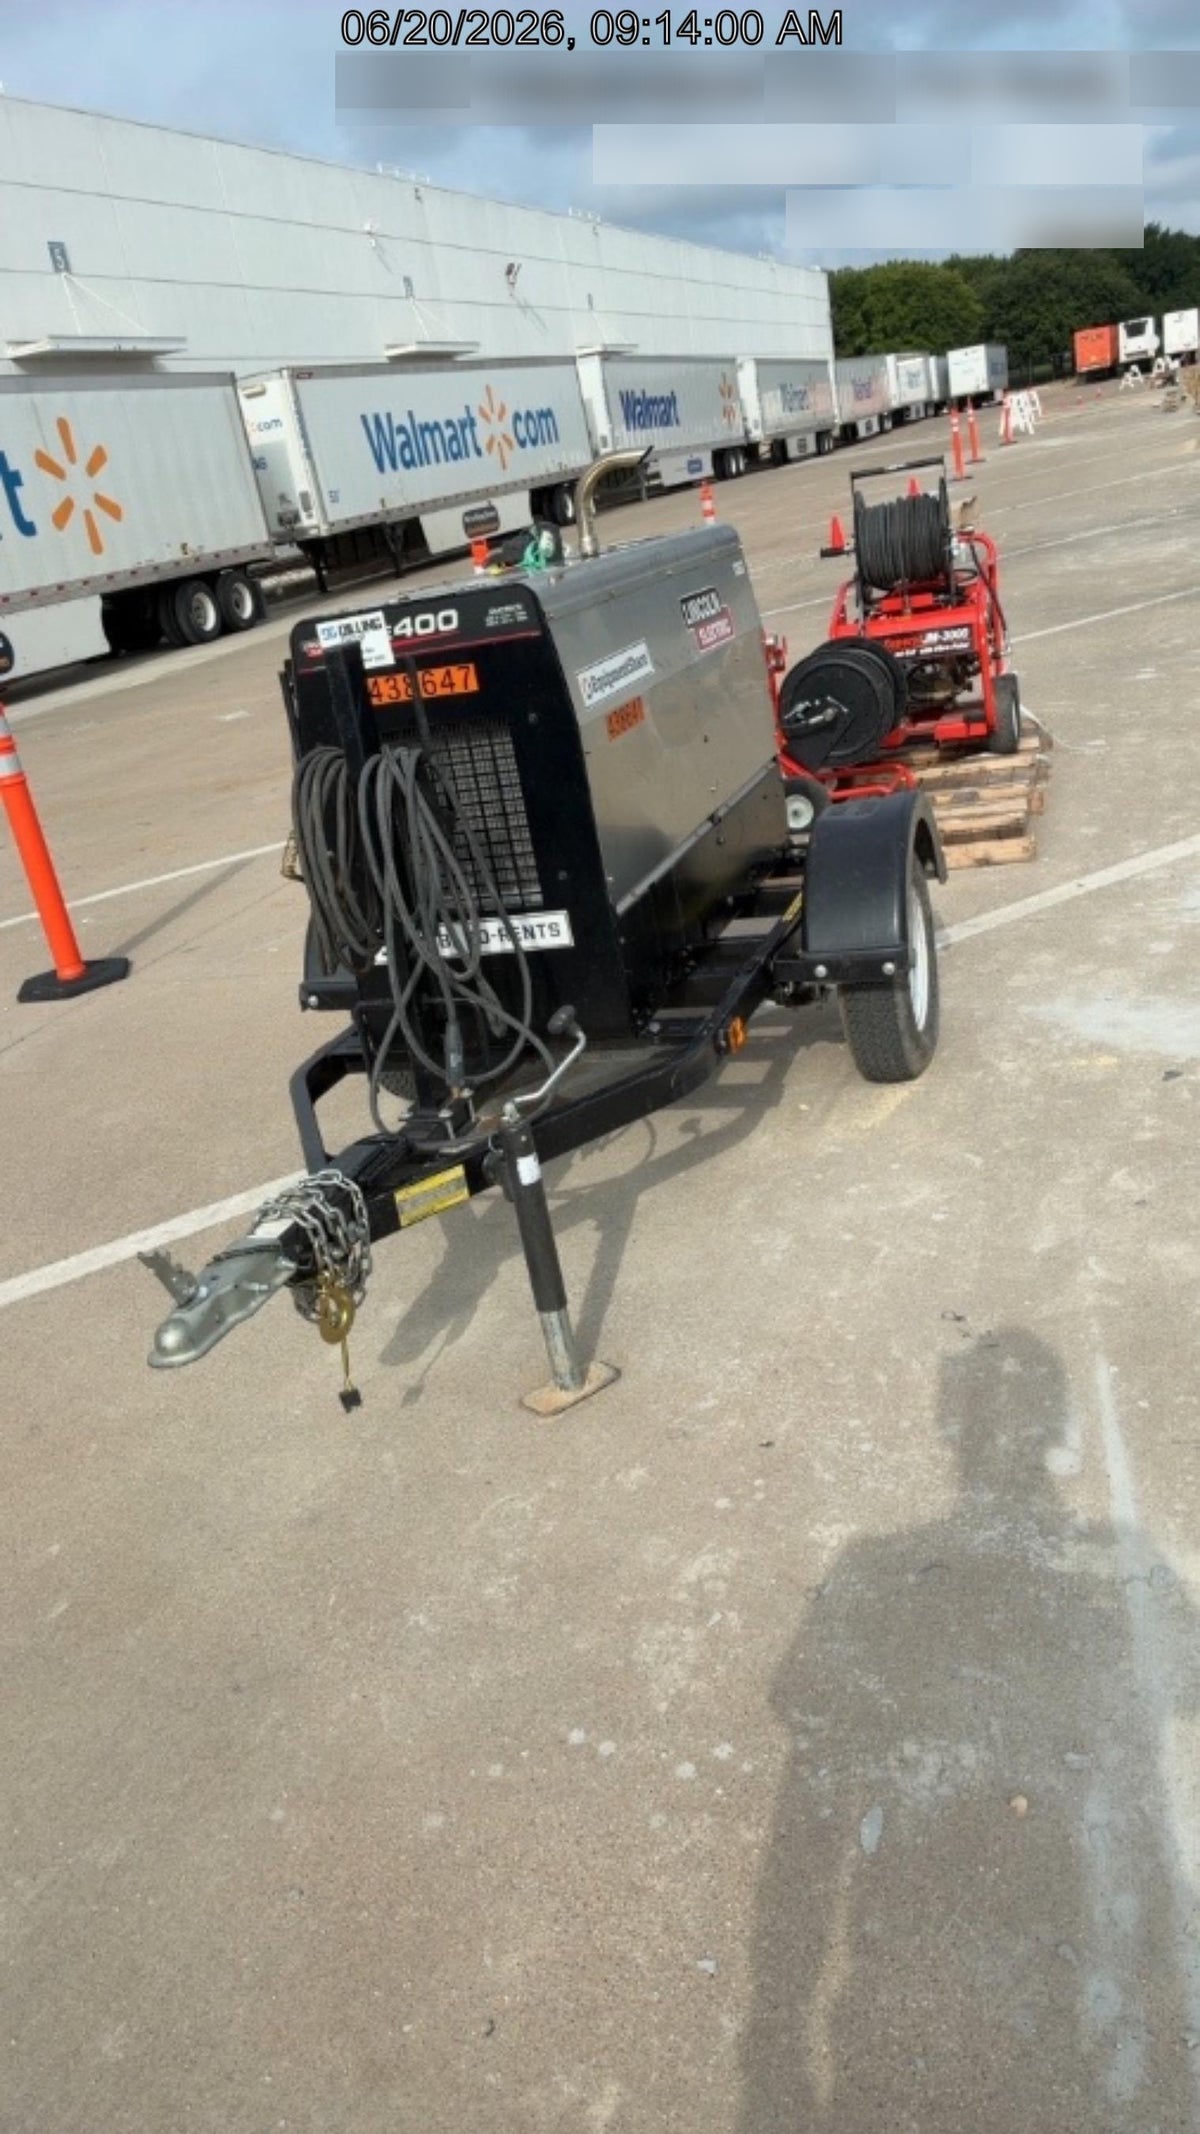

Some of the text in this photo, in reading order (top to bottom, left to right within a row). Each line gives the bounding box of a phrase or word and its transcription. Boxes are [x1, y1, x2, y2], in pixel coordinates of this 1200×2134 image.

[619, 389, 680, 432] Walmart
[360, 405, 483, 474] Walmart
[393, 608, 459, 637] 400
